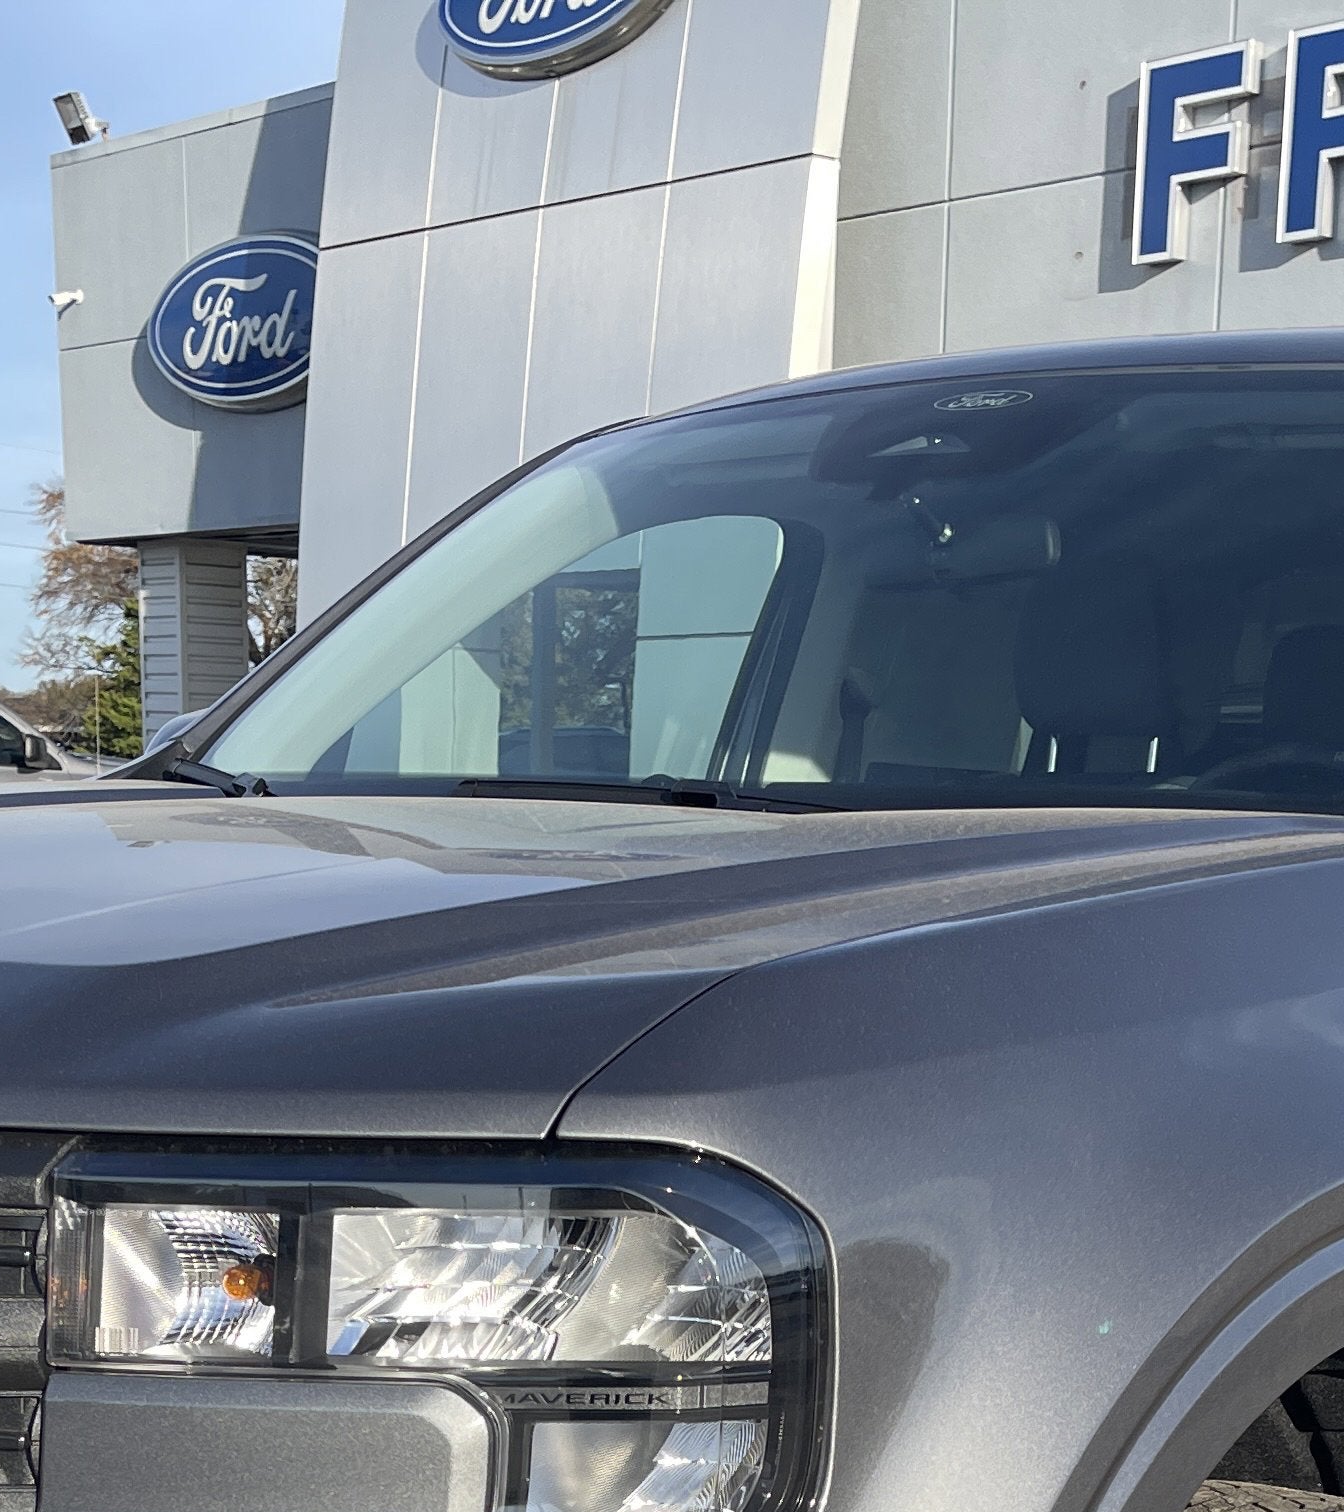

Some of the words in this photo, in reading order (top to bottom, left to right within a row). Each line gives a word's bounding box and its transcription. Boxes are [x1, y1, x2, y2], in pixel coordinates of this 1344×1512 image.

[183, 273, 298, 371] Ford
[948, 392, 1018, 408] Ford
[502, 1392, 669, 1405] MAVERICK
